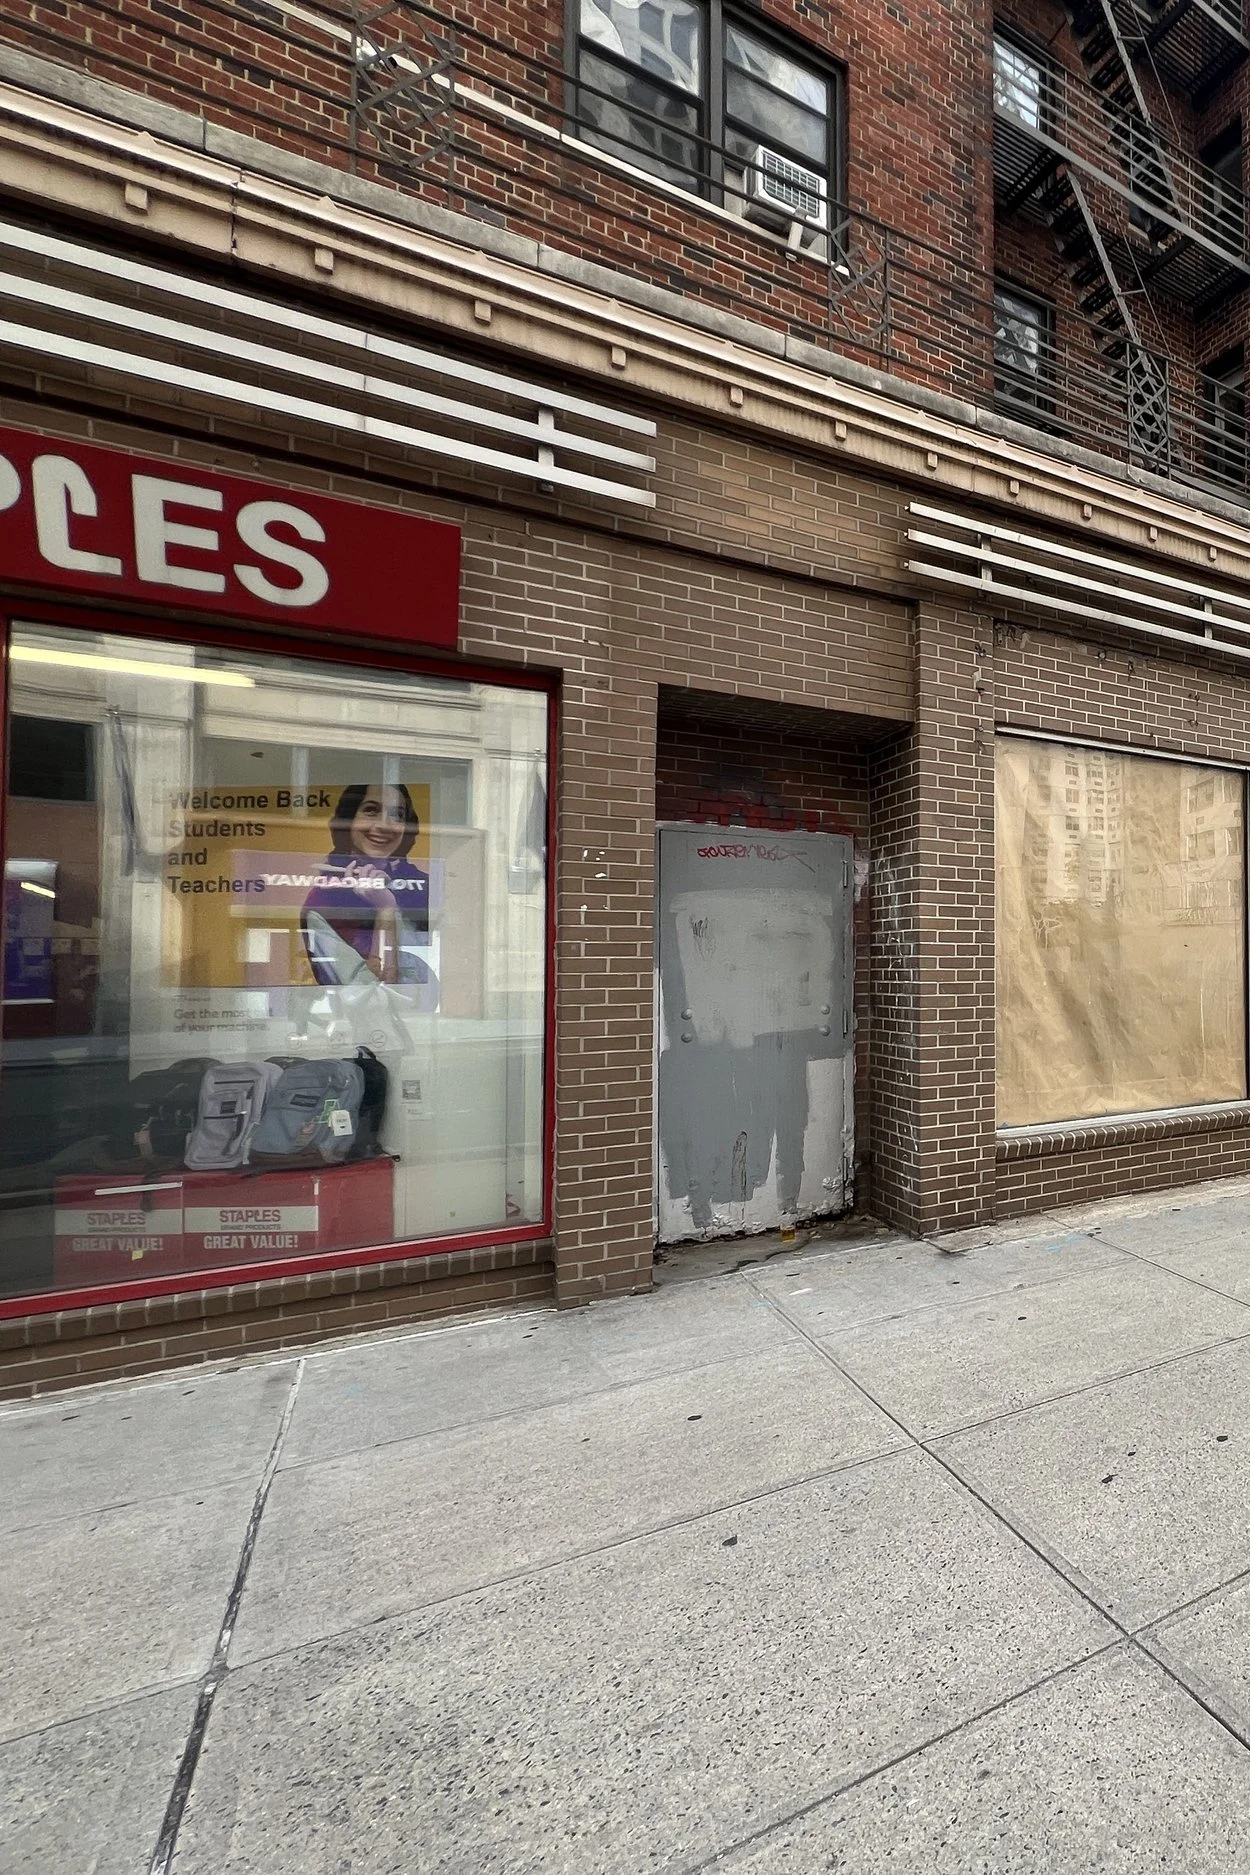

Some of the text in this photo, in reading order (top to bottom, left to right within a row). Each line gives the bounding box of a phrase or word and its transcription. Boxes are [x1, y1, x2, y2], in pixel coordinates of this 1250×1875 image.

[171, 790, 332, 810] Welcome Back
[168, 820, 266, 837] Students
[168, 848, 208, 866] and
[168, 876, 266, 894] Teachers
[87, 1212, 146, 1226] STAPLES
[219, 1209, 281, 1223] STAPLES
[72, 1237, 164, 1252] GREAT VALUE!
[203, 1235, 299, 1250] GREAT VALUE!
